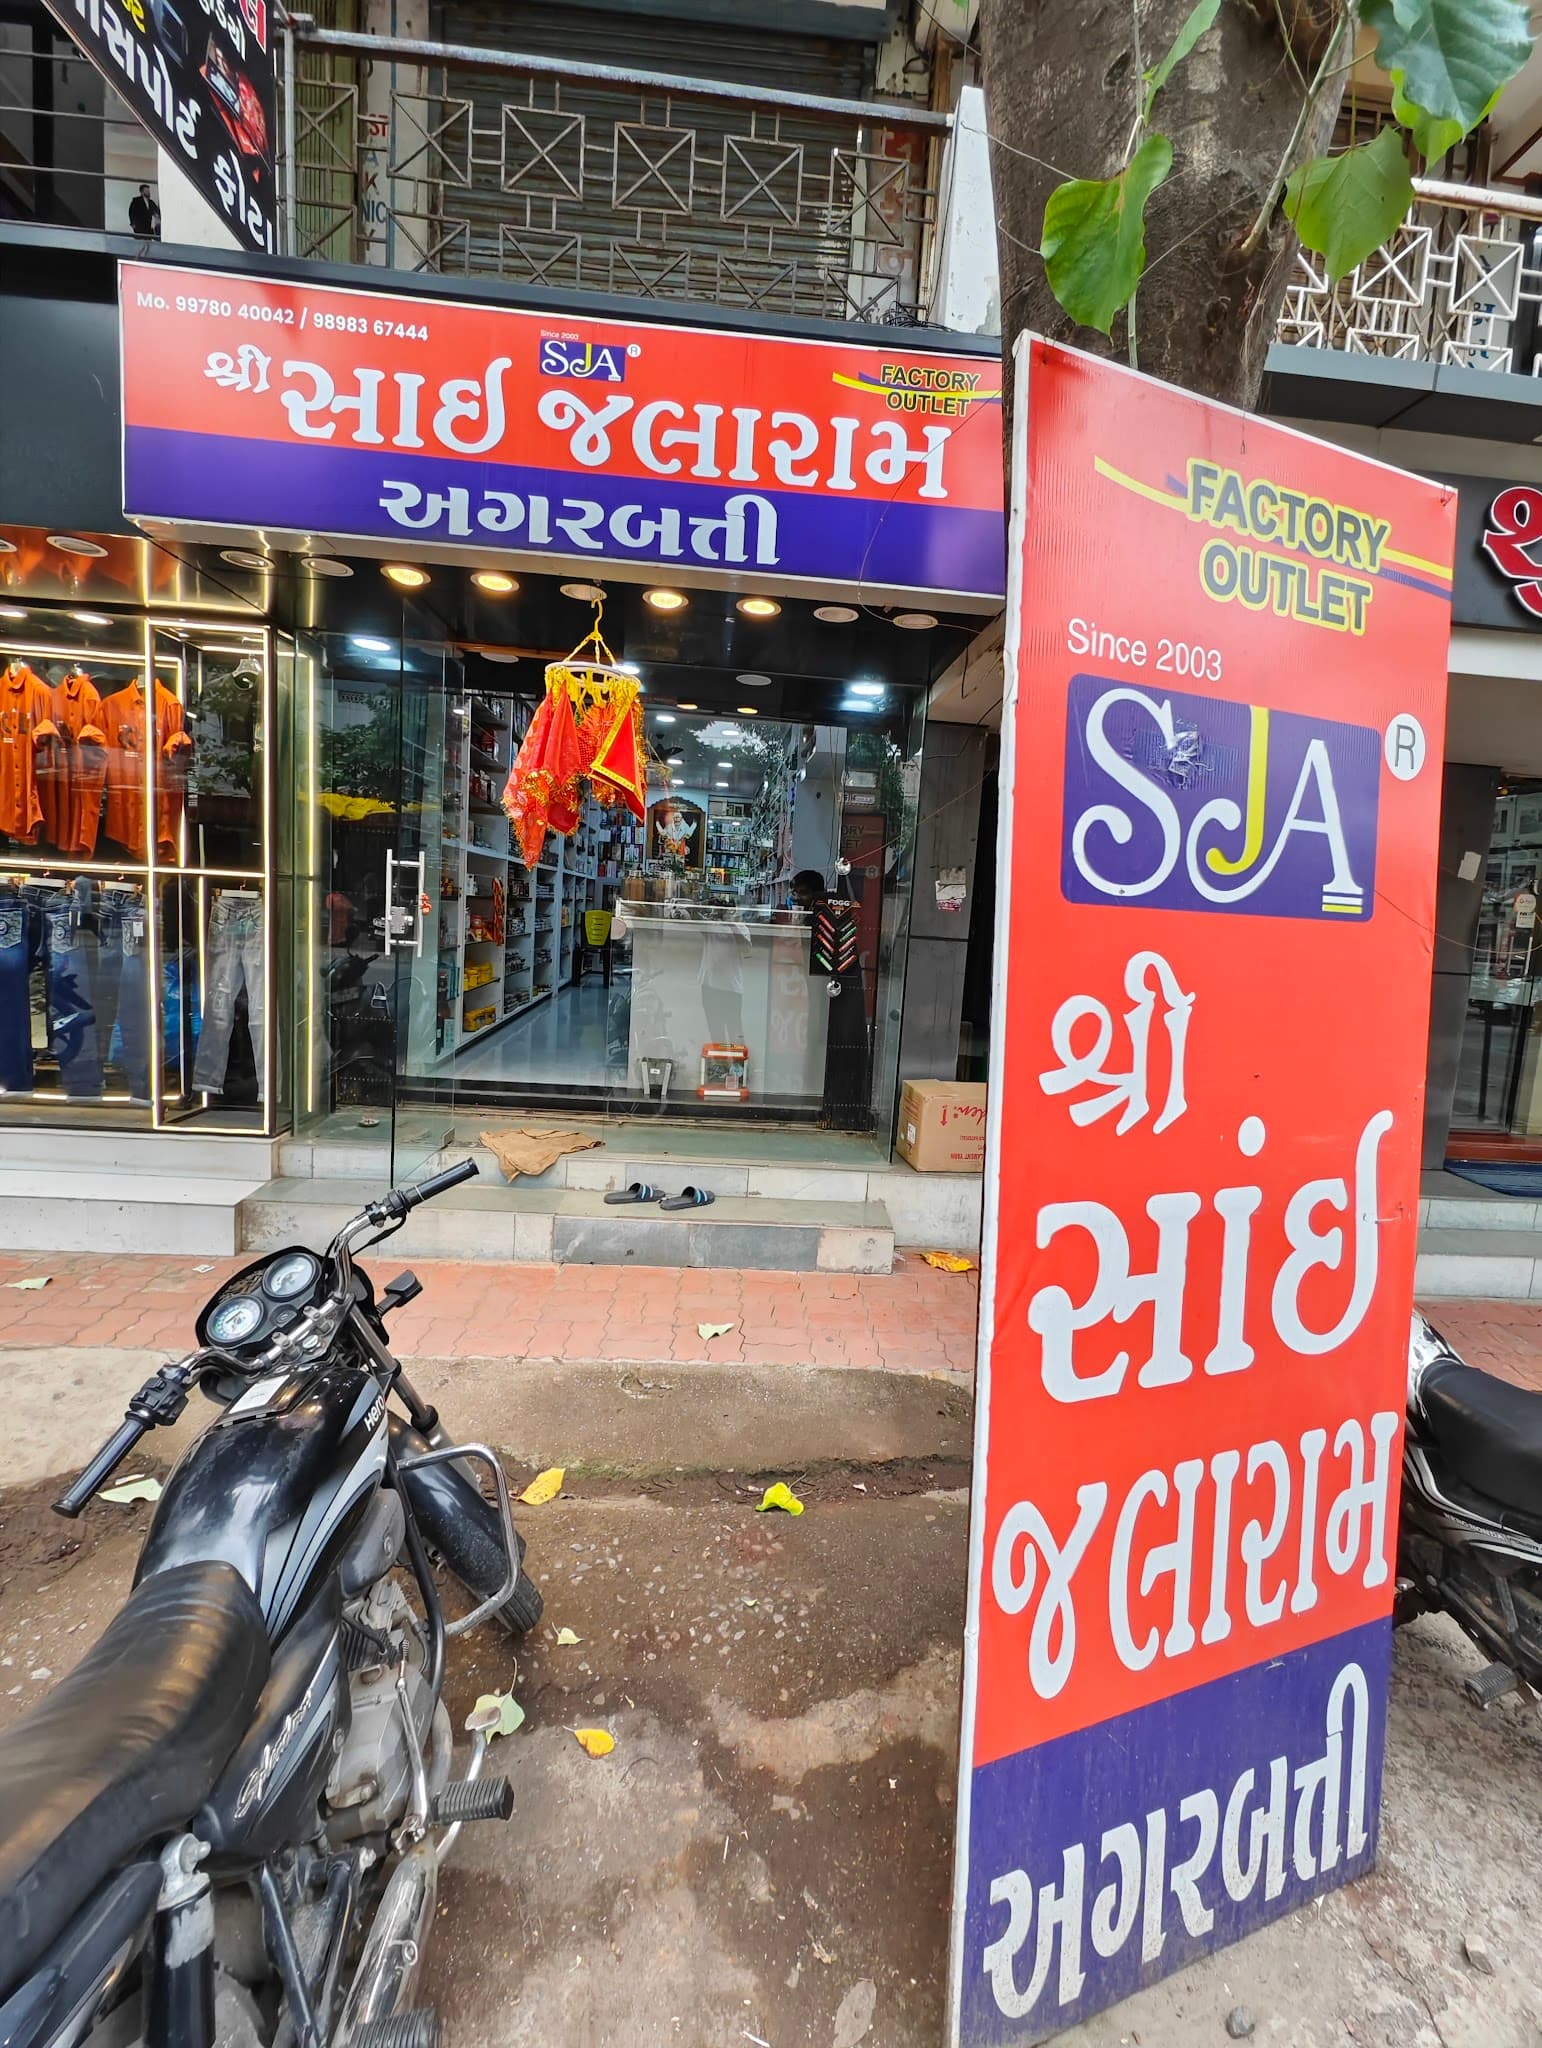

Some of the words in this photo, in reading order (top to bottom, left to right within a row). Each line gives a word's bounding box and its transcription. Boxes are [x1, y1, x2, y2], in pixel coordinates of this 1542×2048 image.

[137, 291, 169, 310] Mo.
[175, 297, 231, 318] 99780
[237, 303, 295, 325] 40042
[300, 307, 308, 330] /
[313, 312, 368, 334] 98983
[374, 320, 429, 341] 67444
[540, 329, 560, 339] Since
[541, 340, 622, 382] SJA
[881, 365, 980, 392] FACTORY
[203, 343, 272, 394] શ્રી
[538, 389, 952, 499] જલારામ
[887, 391, 970, 416] OUTLET
[379, 480, 780, 566] અગરબત્તી
[1186, 458, 1391, 573] FACTORY
[1201, 543, 1374, 636] OUTLET
[1067, 617, 1147, 667] Since
[1155, 638, 1223, 682] 2003
[1071, 687, 1364, 908] SJA
[827, 898, 851, 907] FOGG
[1039, 951, 1196, 1136] શ્રી
[363, 1395, 385, 1432] Hero
[992, 1411, 1399, 1701] જલારામ
[983, 1662, 1370, 2020] અગરબત્તી
